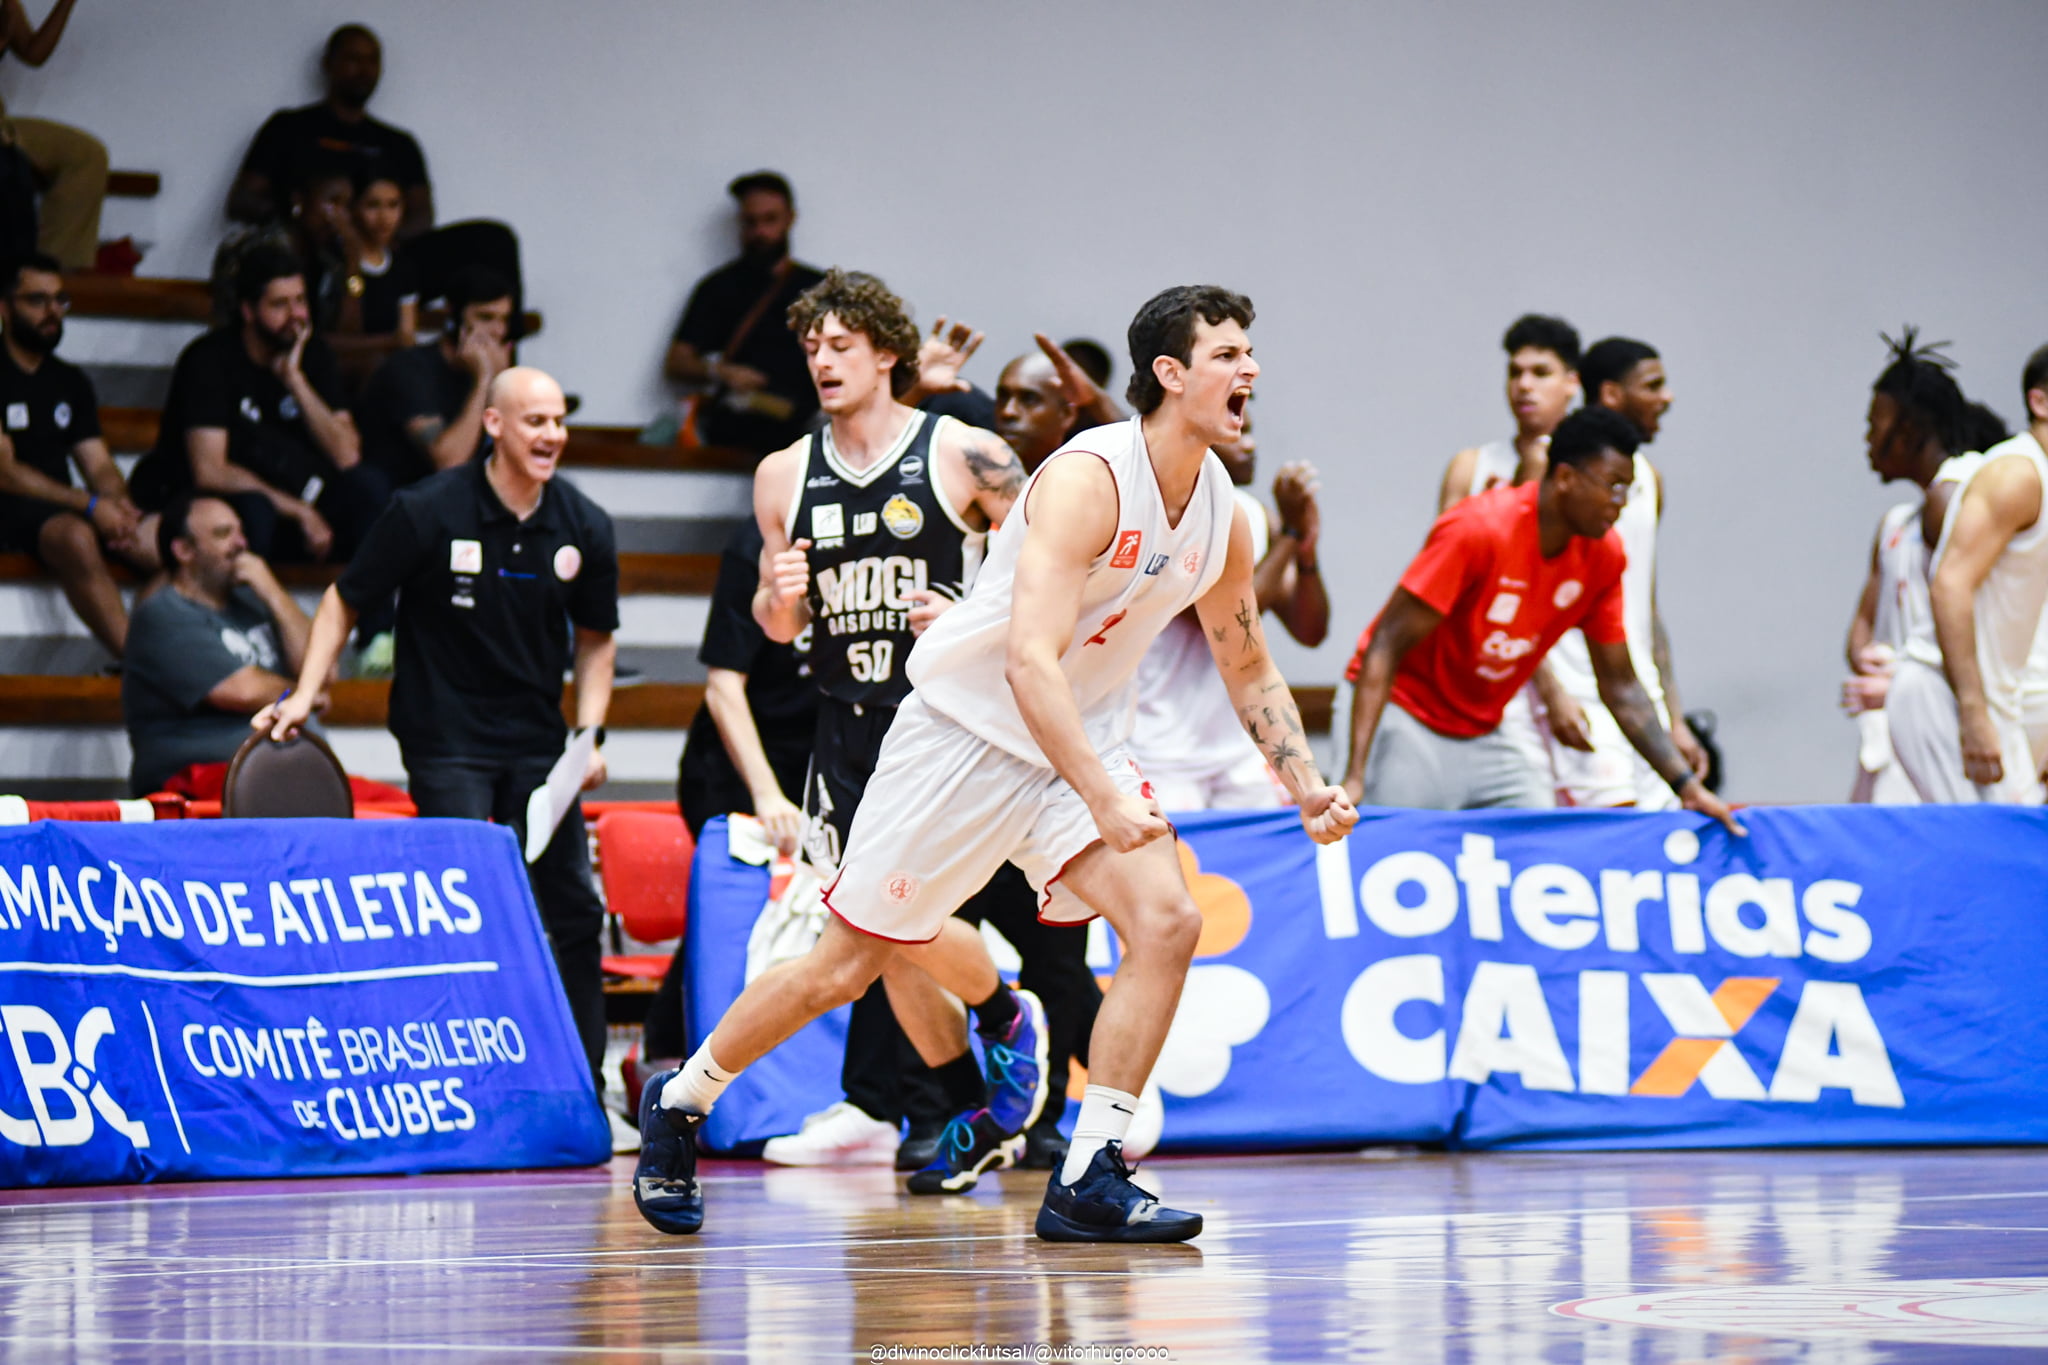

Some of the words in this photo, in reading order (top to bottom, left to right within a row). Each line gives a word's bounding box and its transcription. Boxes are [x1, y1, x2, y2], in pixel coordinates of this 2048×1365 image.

[816, 556, 928, 618] MOGI
[828, 610, 909, 636] BASQUET
[846, 639, 893, 683] 50
[0, 860, 185, 954] MAÇÃO
[183, 880, 265, 947] DE
[271, 868, 482, 946] ATLETAS
[1314, 829, 1873, 963] loterias
[182, 1016, 342, 1081] COMITÊ
[340, 1016, 526, 1075] BRASILEIRO
[1341, 954, 1906, 1109] CAIXA
[296, 1101, 327, 1129] DE
[326, 1078, 476, 1140] CLUBES
